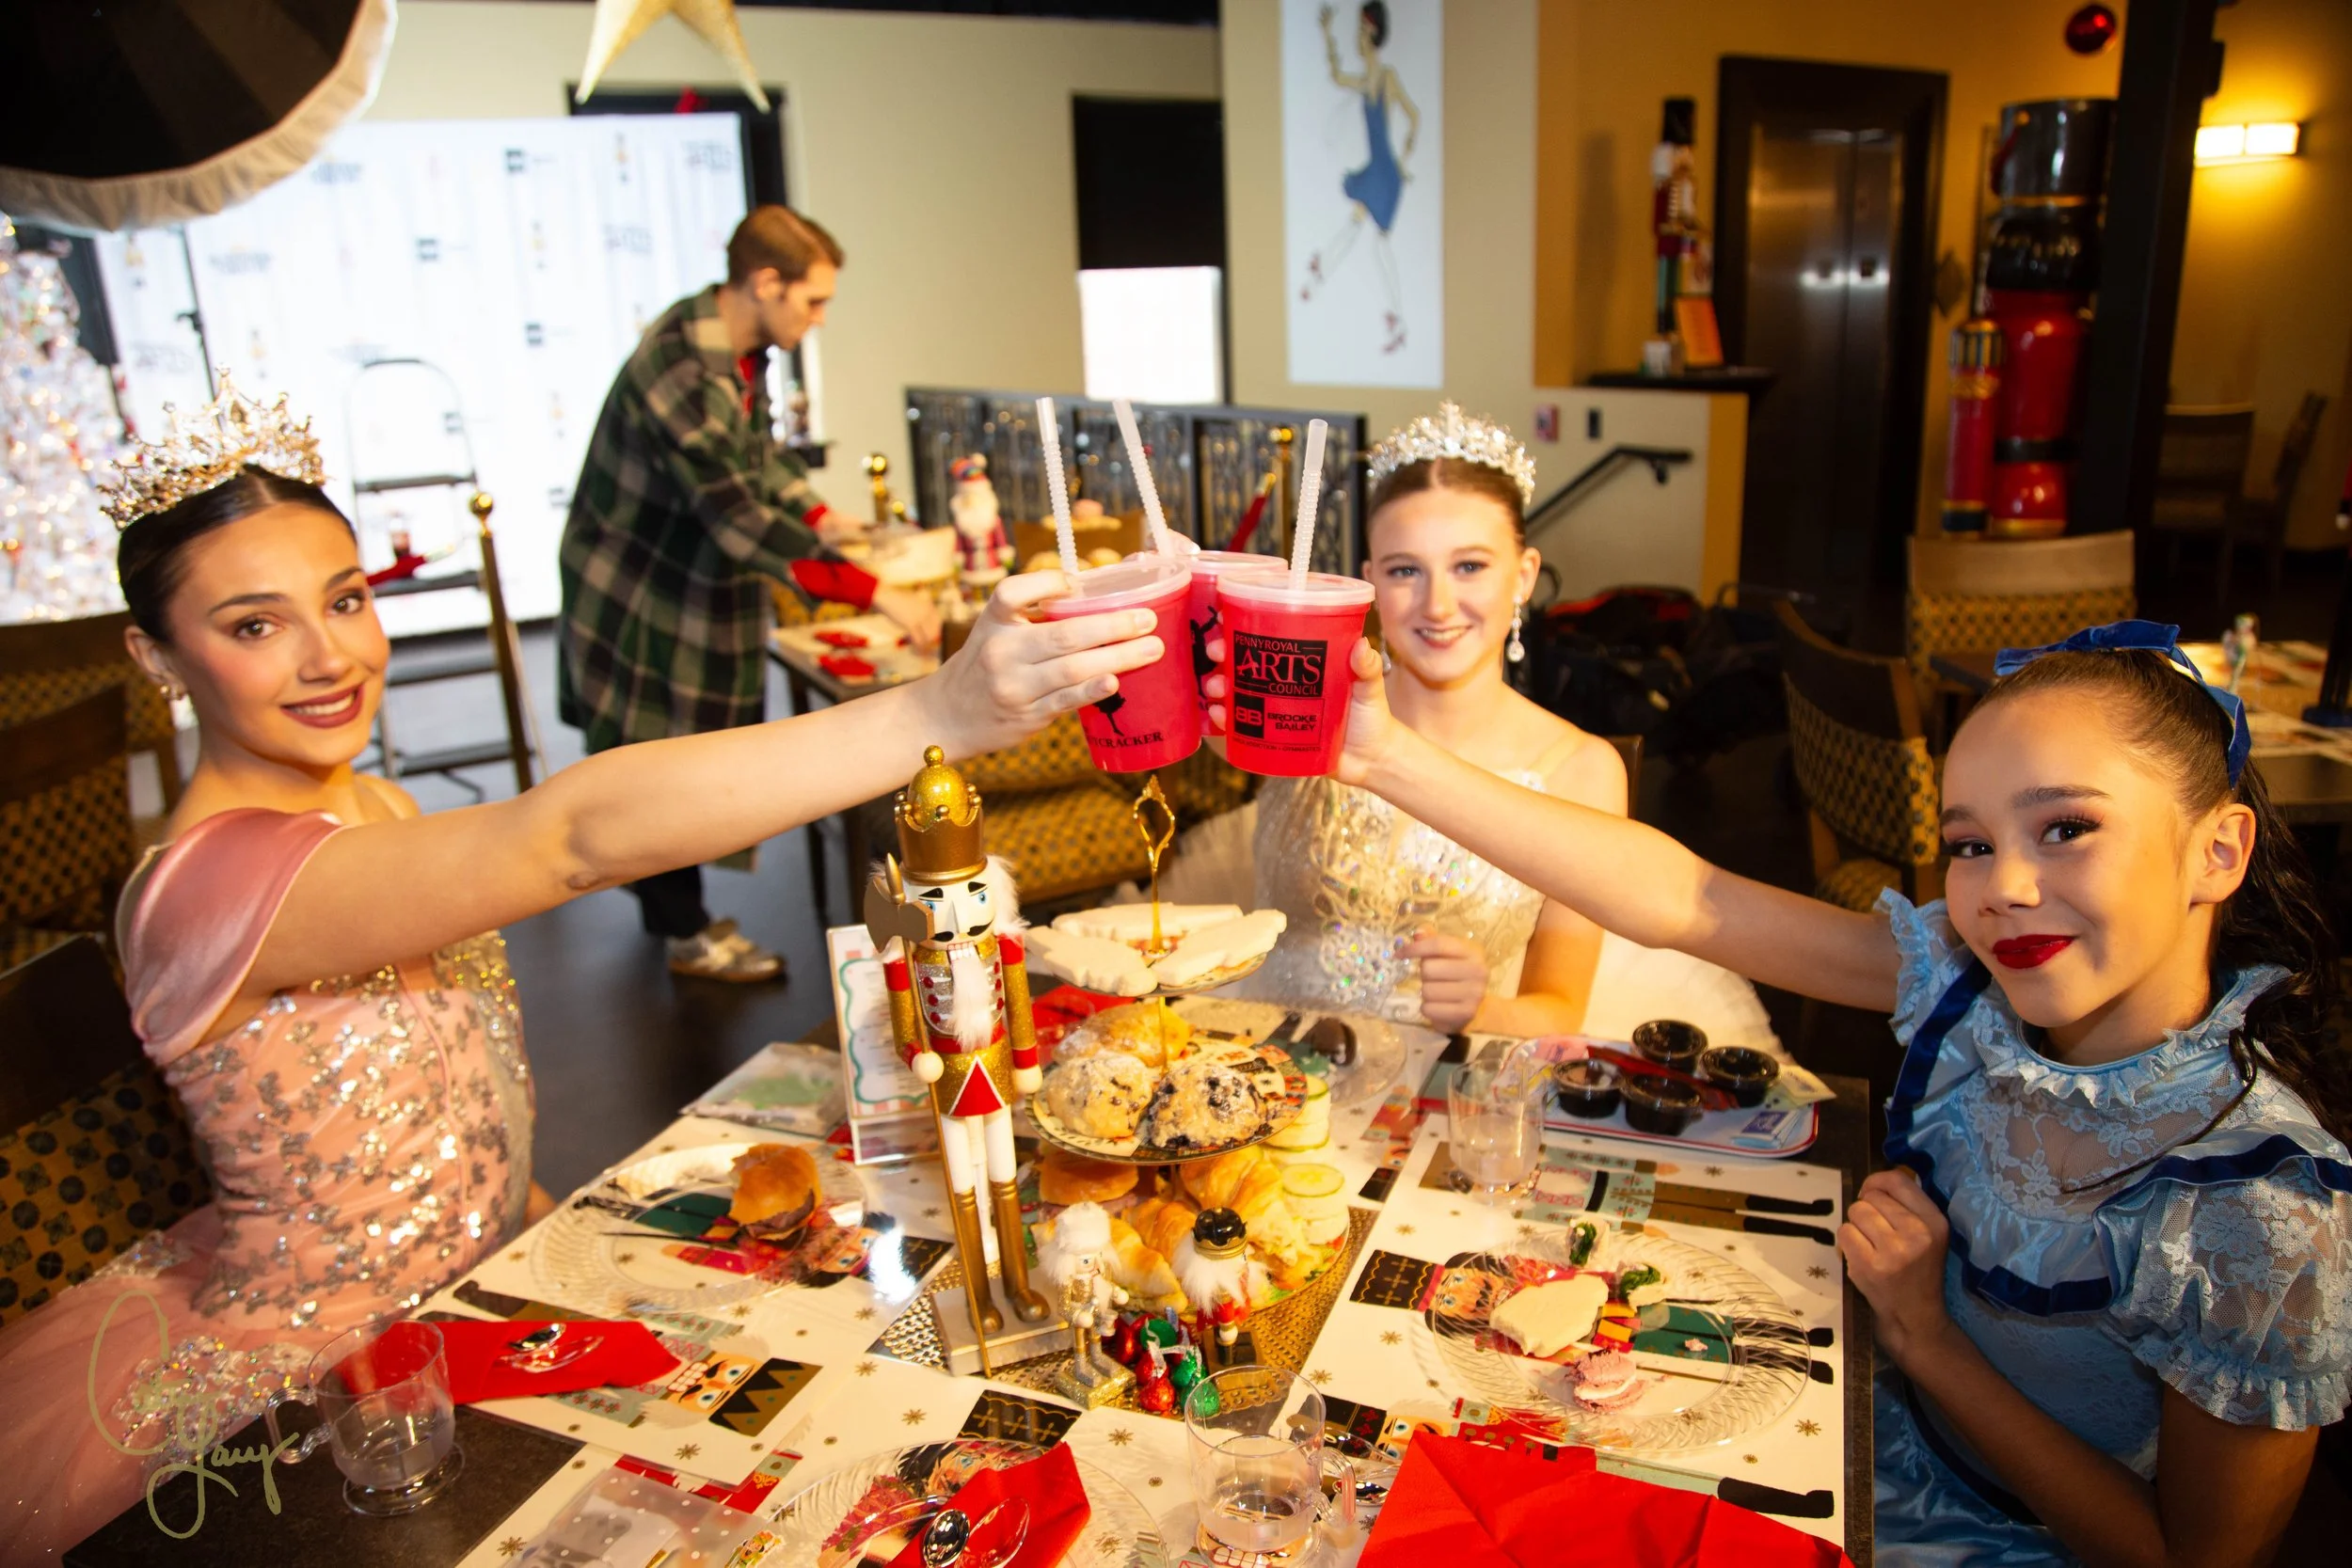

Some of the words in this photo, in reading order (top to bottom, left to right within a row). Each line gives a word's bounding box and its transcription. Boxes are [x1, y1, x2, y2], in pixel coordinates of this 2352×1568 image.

[1234, 634, 1301, 653] PENNYROYAL
[1236, 647, 1322, 685] ARTS
[1268, 682, 1319, 695] COUNCIL
[1267, 712, 1317, 723] BROOKE
[1275, 721, 1316, 732] BAILEY
